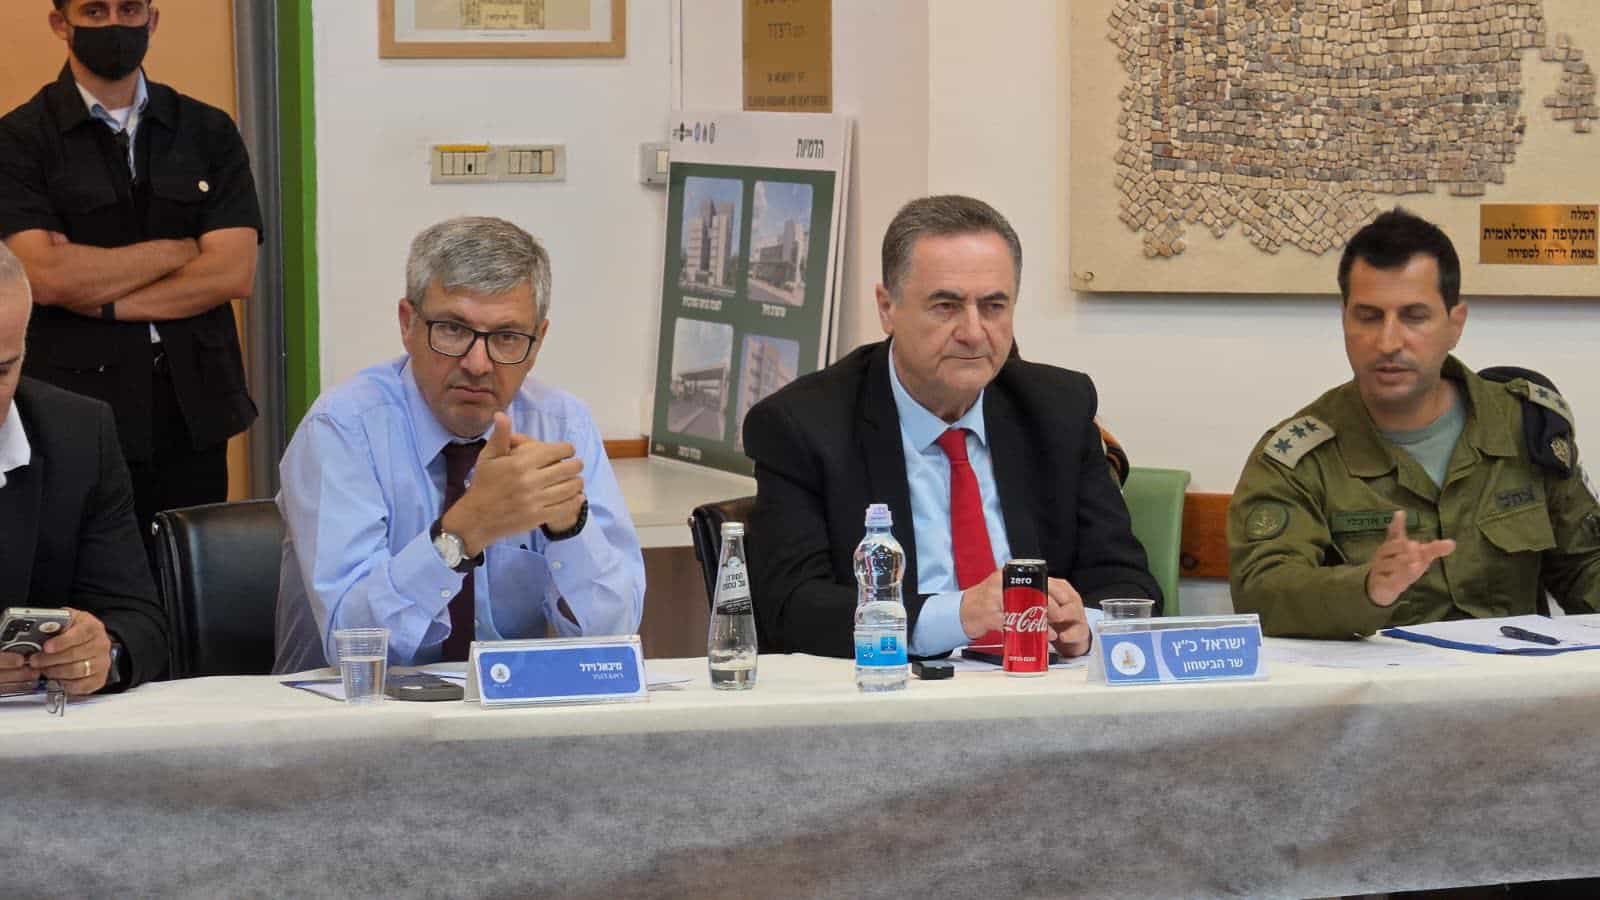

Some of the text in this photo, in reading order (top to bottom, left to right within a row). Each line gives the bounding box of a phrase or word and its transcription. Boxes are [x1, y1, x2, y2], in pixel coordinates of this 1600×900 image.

[796, 138, 824, 159] הדמיות
[1570, 205, 1595, 220] רמלה
[1483, 223, 1595, 245] התקופה האיסלאמית
[1507, 244, 1539, 258] לספירה
[1570, 248, 1594, 258] מאות
[1010, 577, 1032, 585] zero
[1172, 637, 1246, 656] ישראל כ"ץ
[1184, 659, 1243, 672] שר הביטחון
